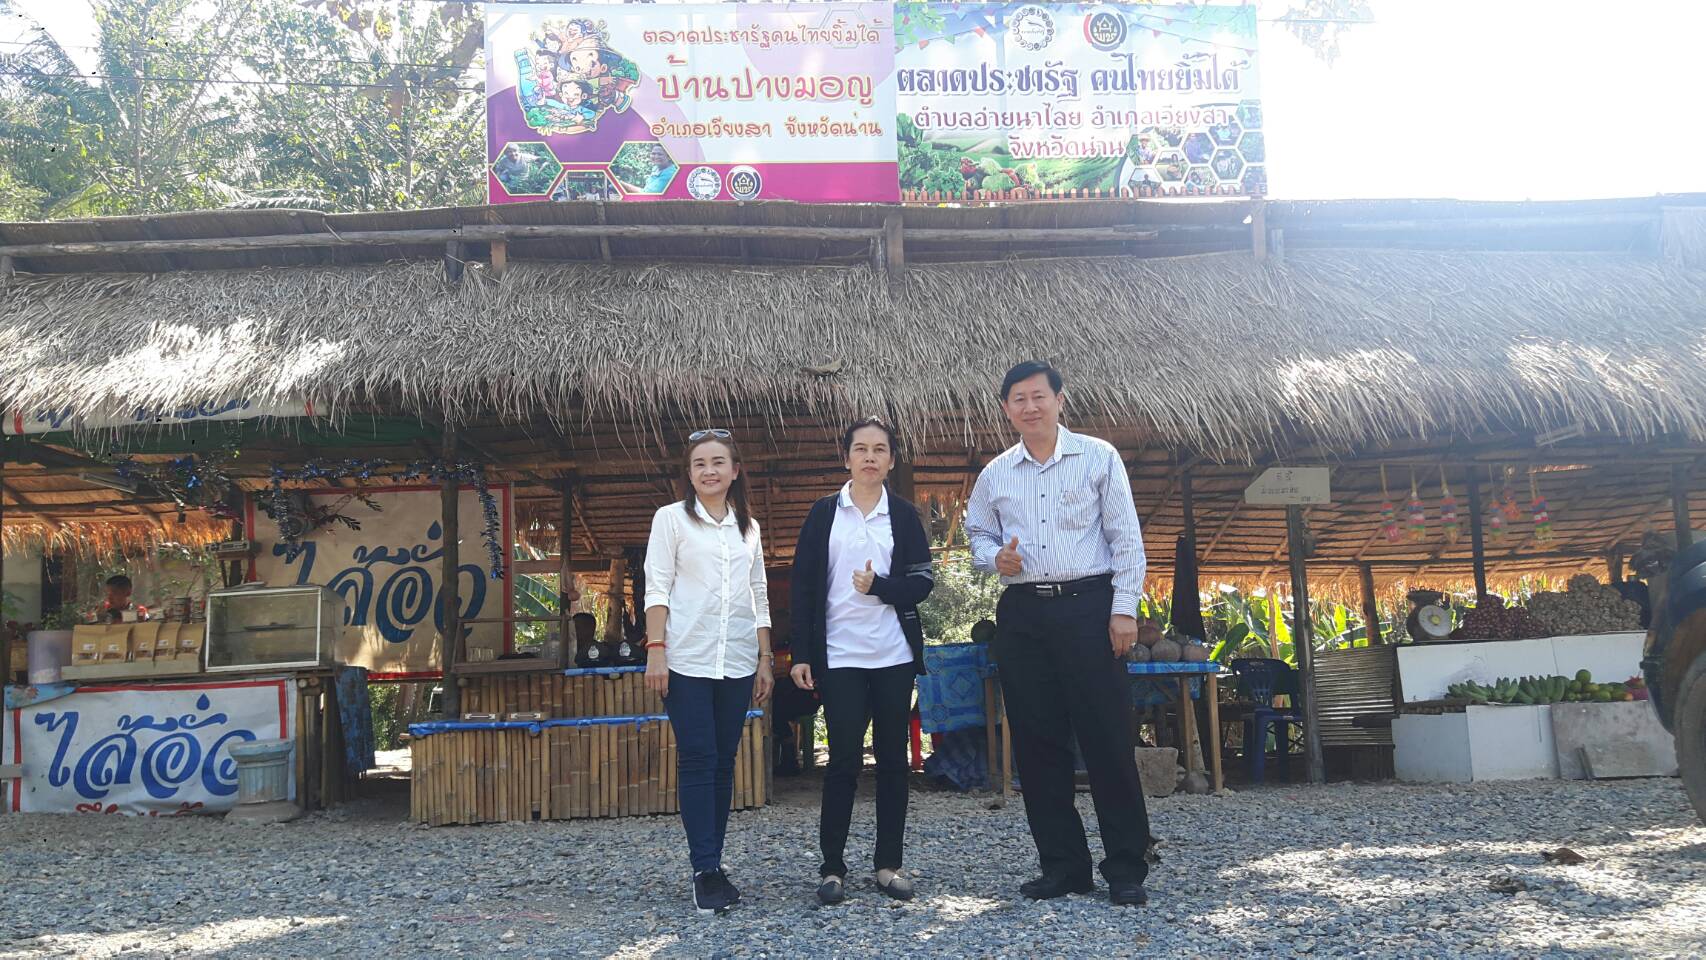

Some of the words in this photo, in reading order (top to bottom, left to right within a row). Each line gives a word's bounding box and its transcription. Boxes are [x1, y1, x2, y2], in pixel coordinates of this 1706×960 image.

[643, 18, 883, 48] ตลาดประชารัฐคนไทยยิ้มได้
[656, 55, 873, 105] บ้านปางมอญ
[897, 60, 1079, 98] ตลาดประชารัฐ
[1091, 52, 1249, 91] คนไทยยิ้มได้
[651, 116, 771, 137] อำเภอเวียงสา
[784, 112, 883, 137] จังหวัดน่าน
[914, 102, 1082, 128] ตำบลอ่ายนาไลย
[1091, 105, 1228, 126] อำเภอเวียงสา
[1009, 134, 1125, 156] จังหวัดน่าน
